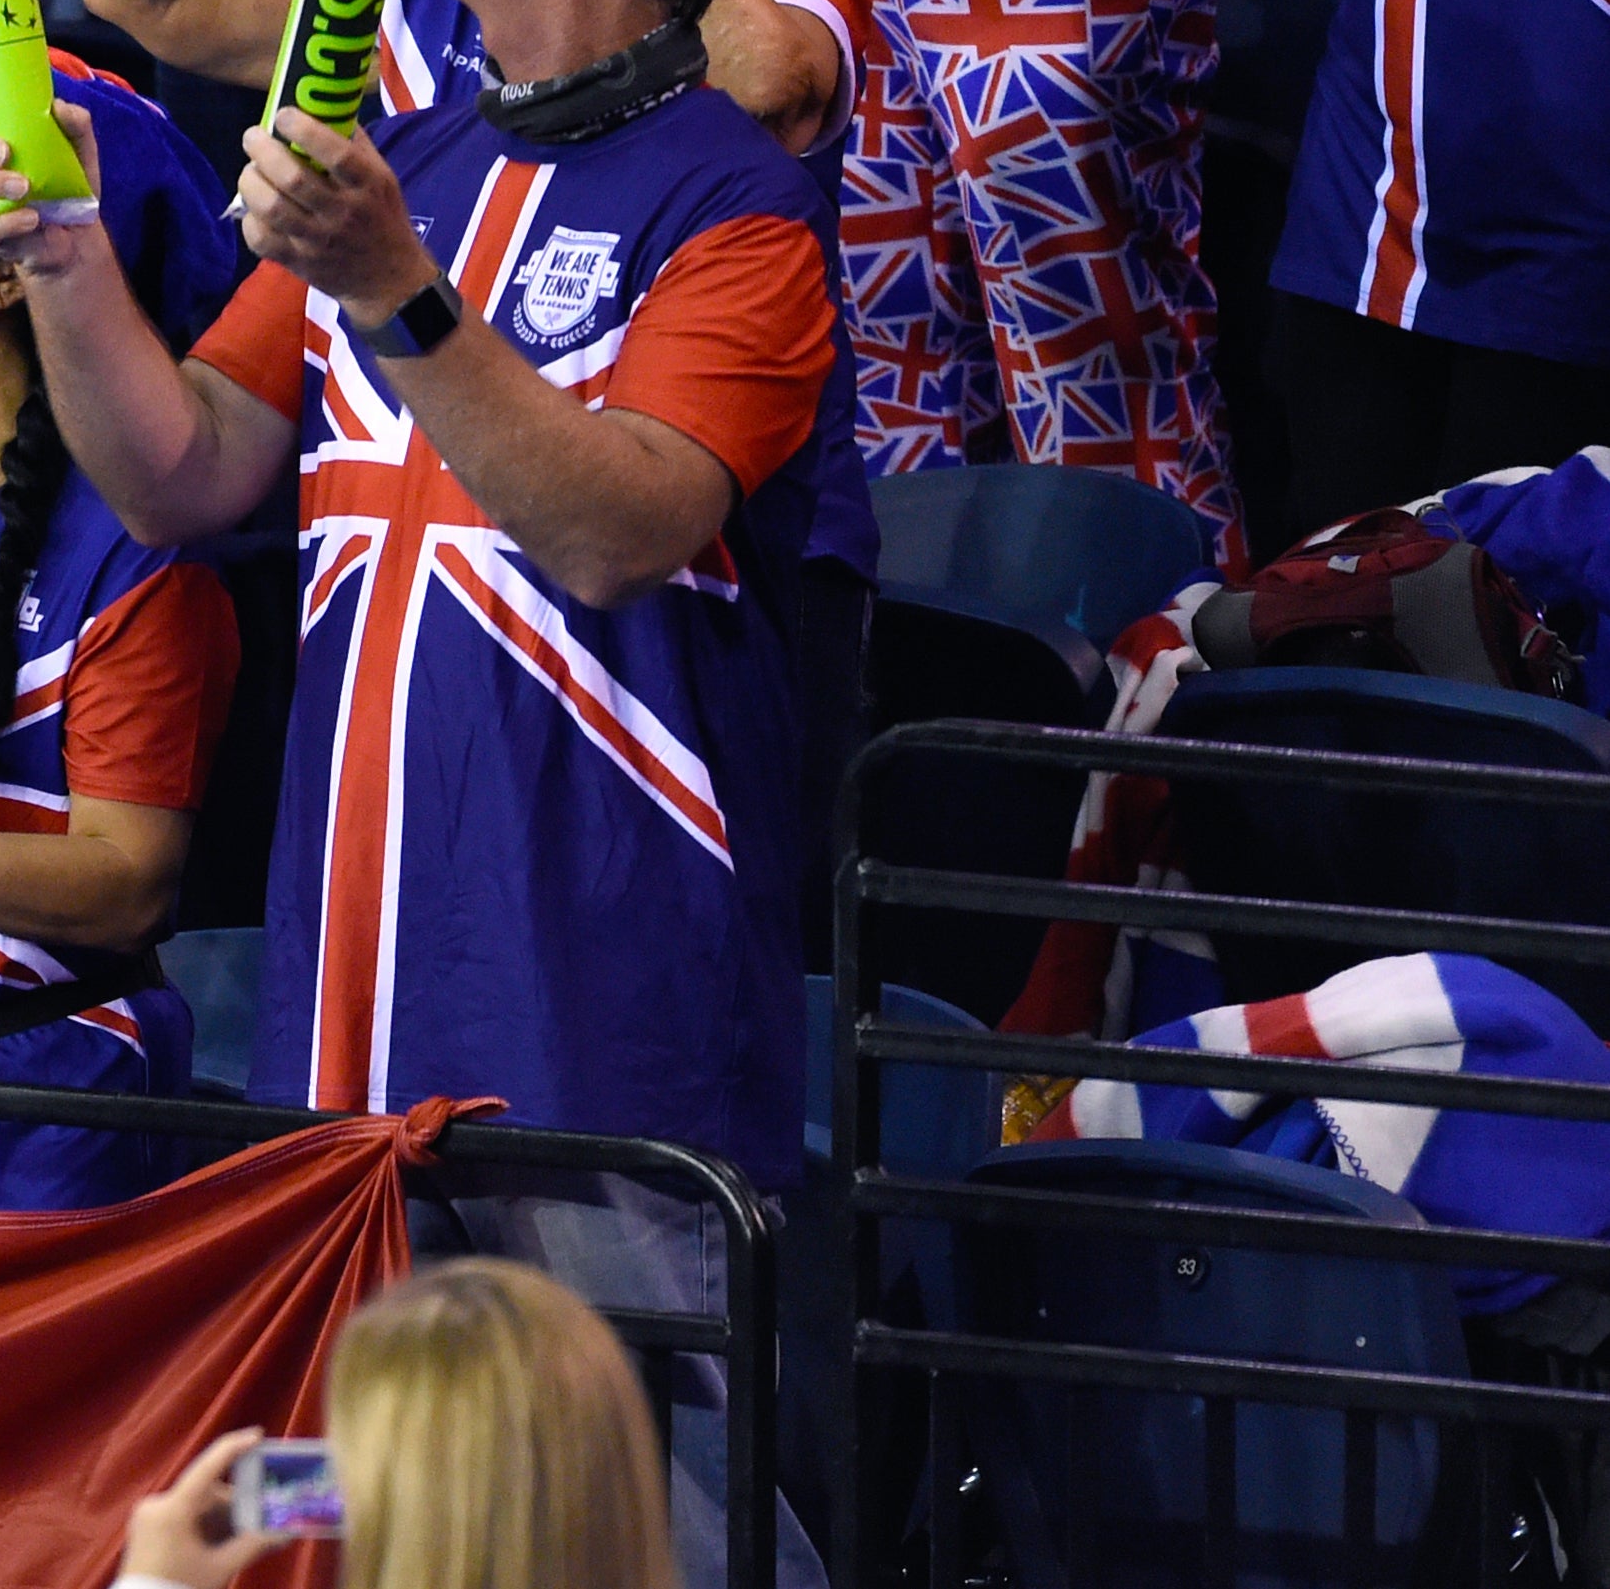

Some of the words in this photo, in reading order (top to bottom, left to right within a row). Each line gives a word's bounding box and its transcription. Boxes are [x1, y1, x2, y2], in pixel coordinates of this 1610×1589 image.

[549, 249, 575, 272] WE
[569, 251, 601, 275] ARE
[539, 273, 590, 301] TENNIS
[546, 299, 582, 311] ACADEMY
[1177, 1257, 1197, 1276] 33
